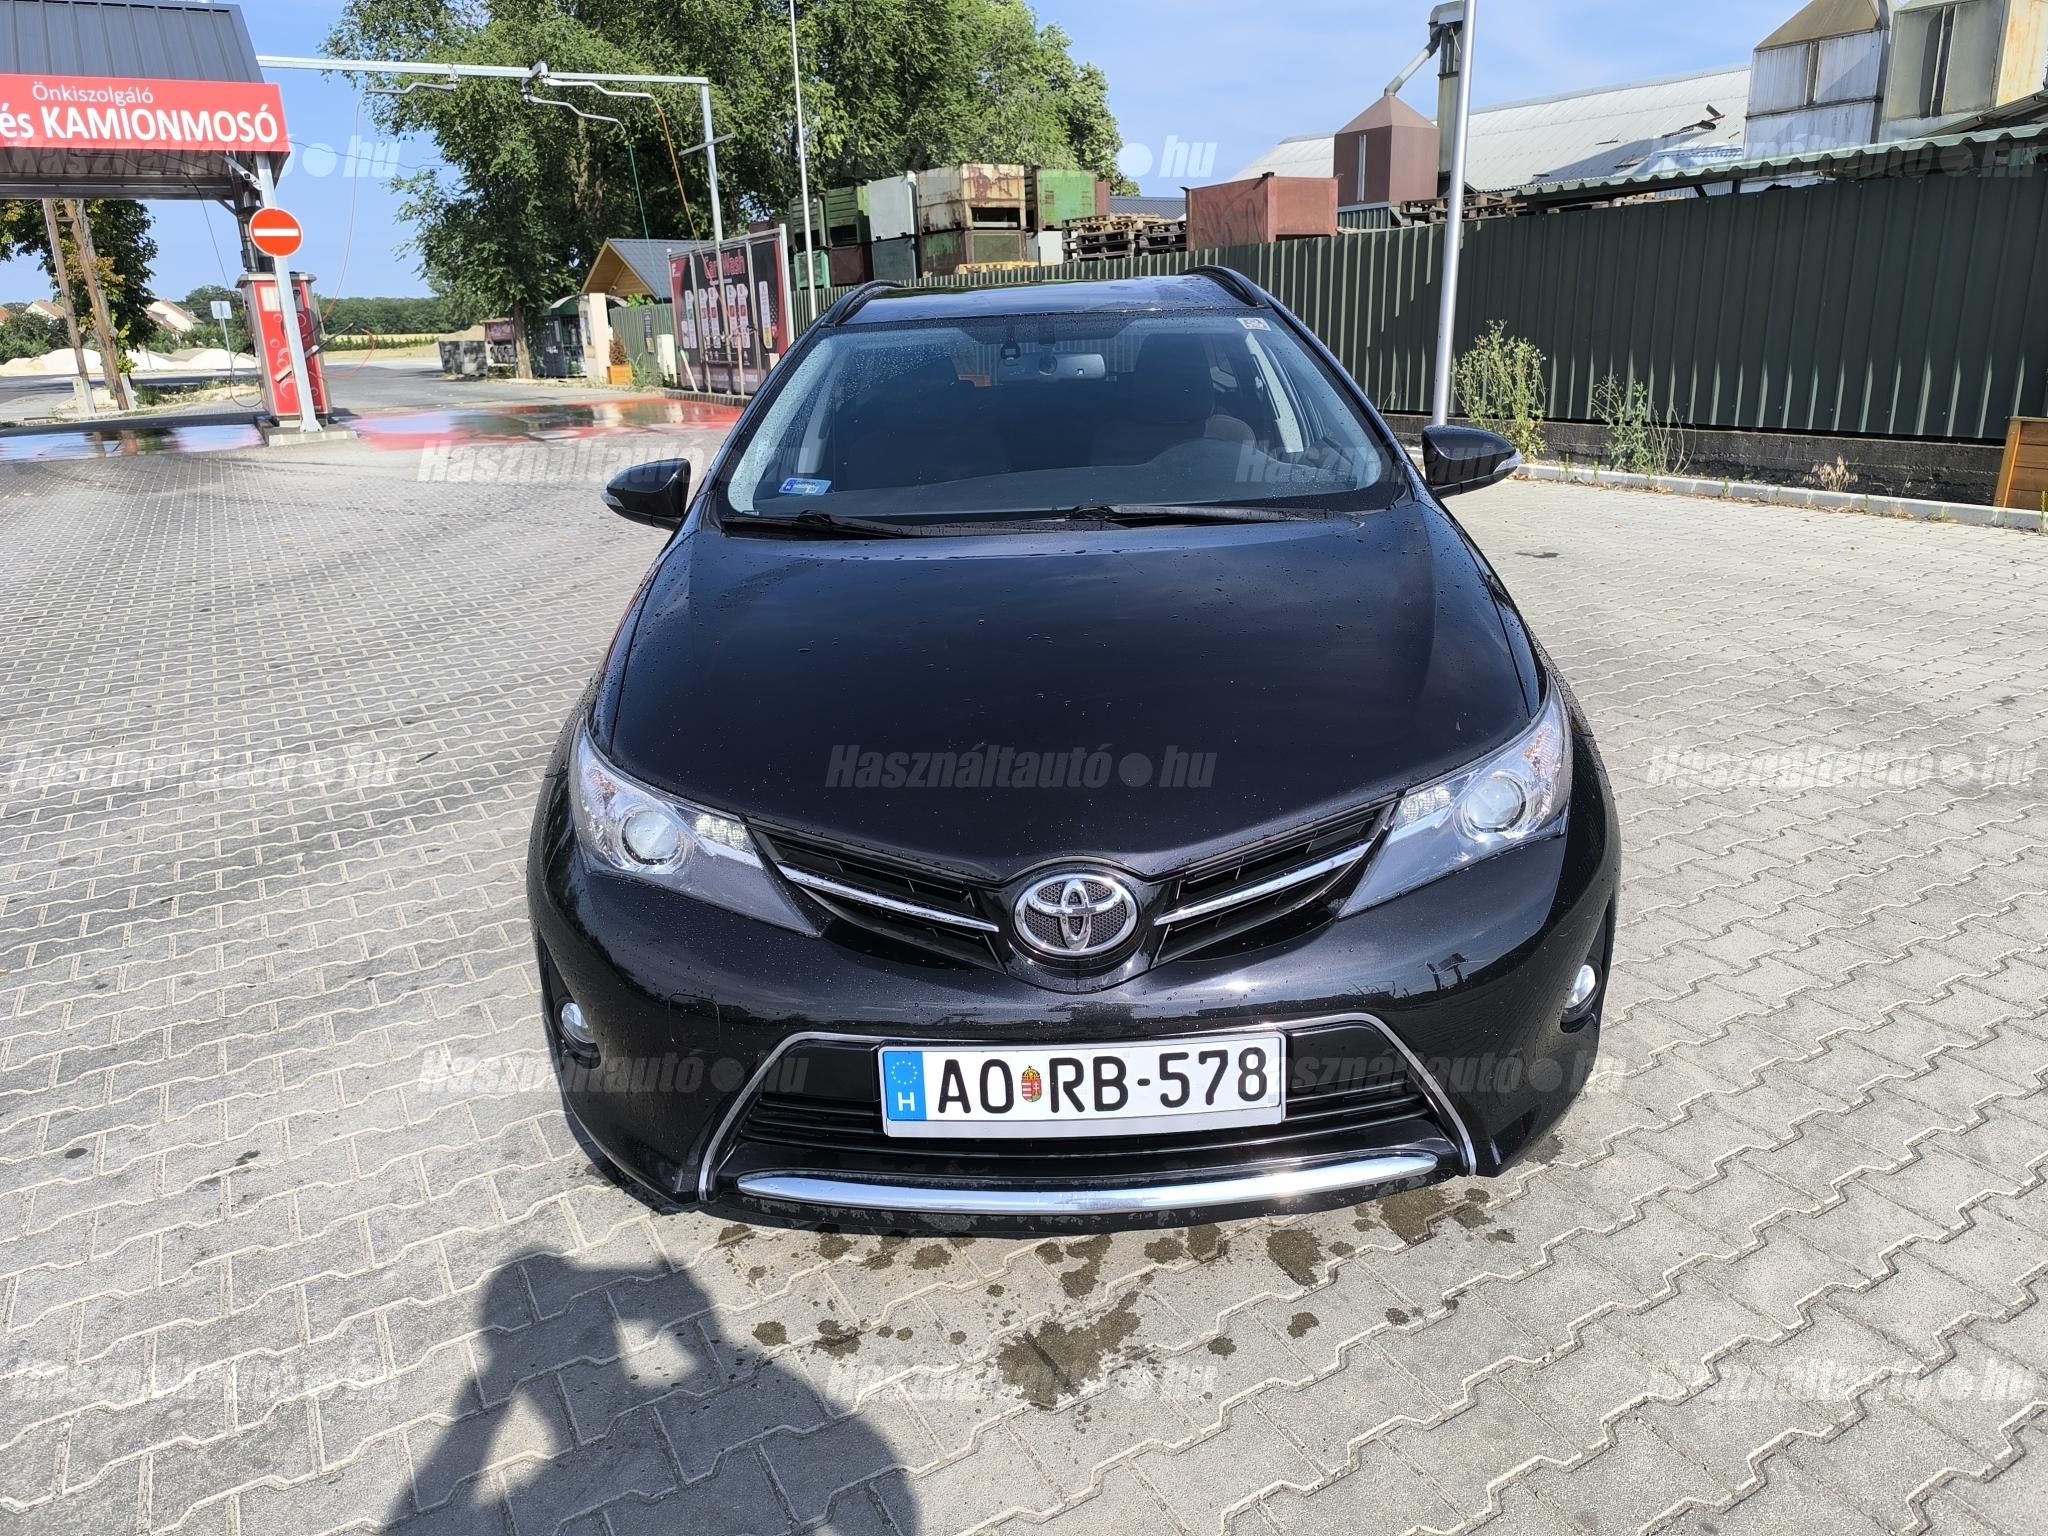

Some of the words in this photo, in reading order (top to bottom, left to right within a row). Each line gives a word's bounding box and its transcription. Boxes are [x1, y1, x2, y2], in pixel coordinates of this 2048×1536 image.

[32, 81, 154, 107] Önkiszolgáló
[0, 102, 35, 138] és
[41, 103, 278, 143] KAMIONMOSÓ
[937, 1058, 1015, 1114] AO
[1048, 1046, 1268, 1114] RB-578
[897, 1092, 915, 1112] H
